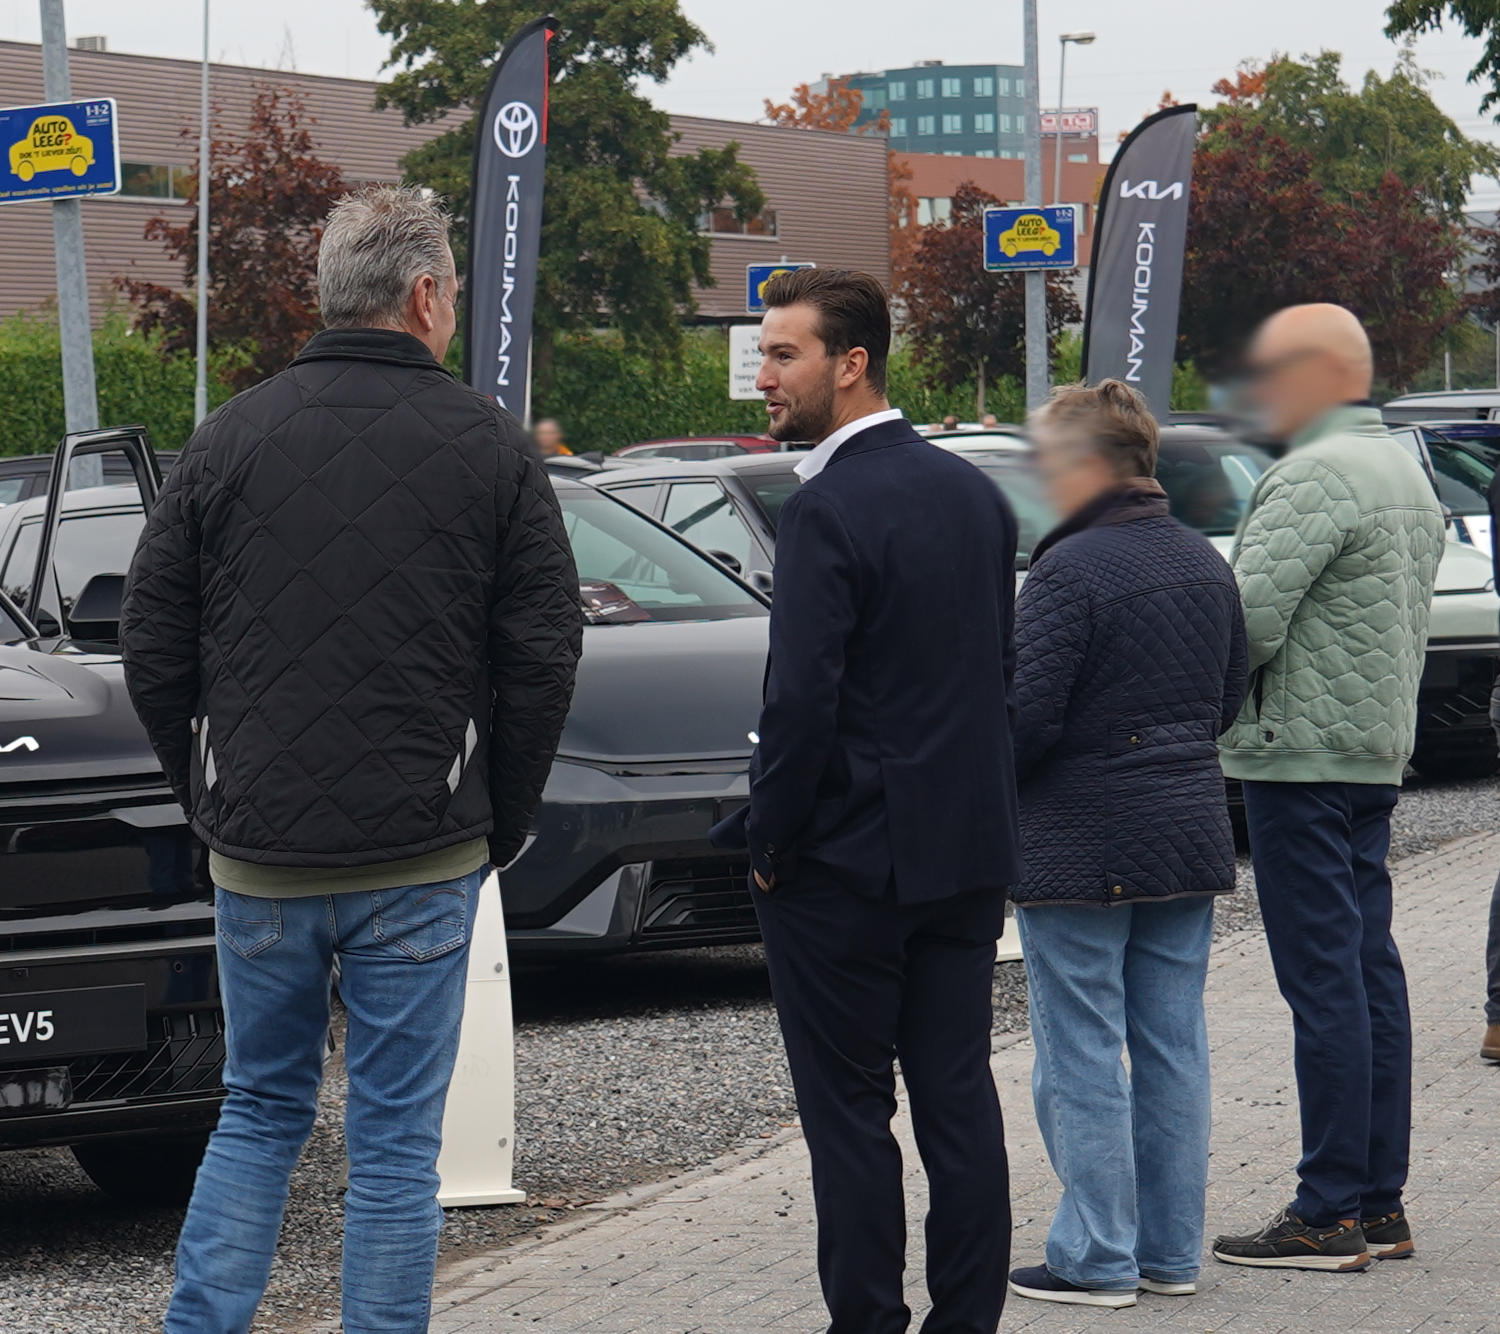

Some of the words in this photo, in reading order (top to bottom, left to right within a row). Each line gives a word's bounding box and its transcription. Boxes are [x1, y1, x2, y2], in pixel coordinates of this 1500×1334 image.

[32, 121, 68, 136] AUTO
[33, 133, 73, 149] LEEG?
[1119, 179, 1184, 201] KIA
[1017, 218, 1043, 227] AUTO
[496, 175, 521, 387] KOOIJMAN
[1125, 222, 1156, 382] KOOIJMAN
